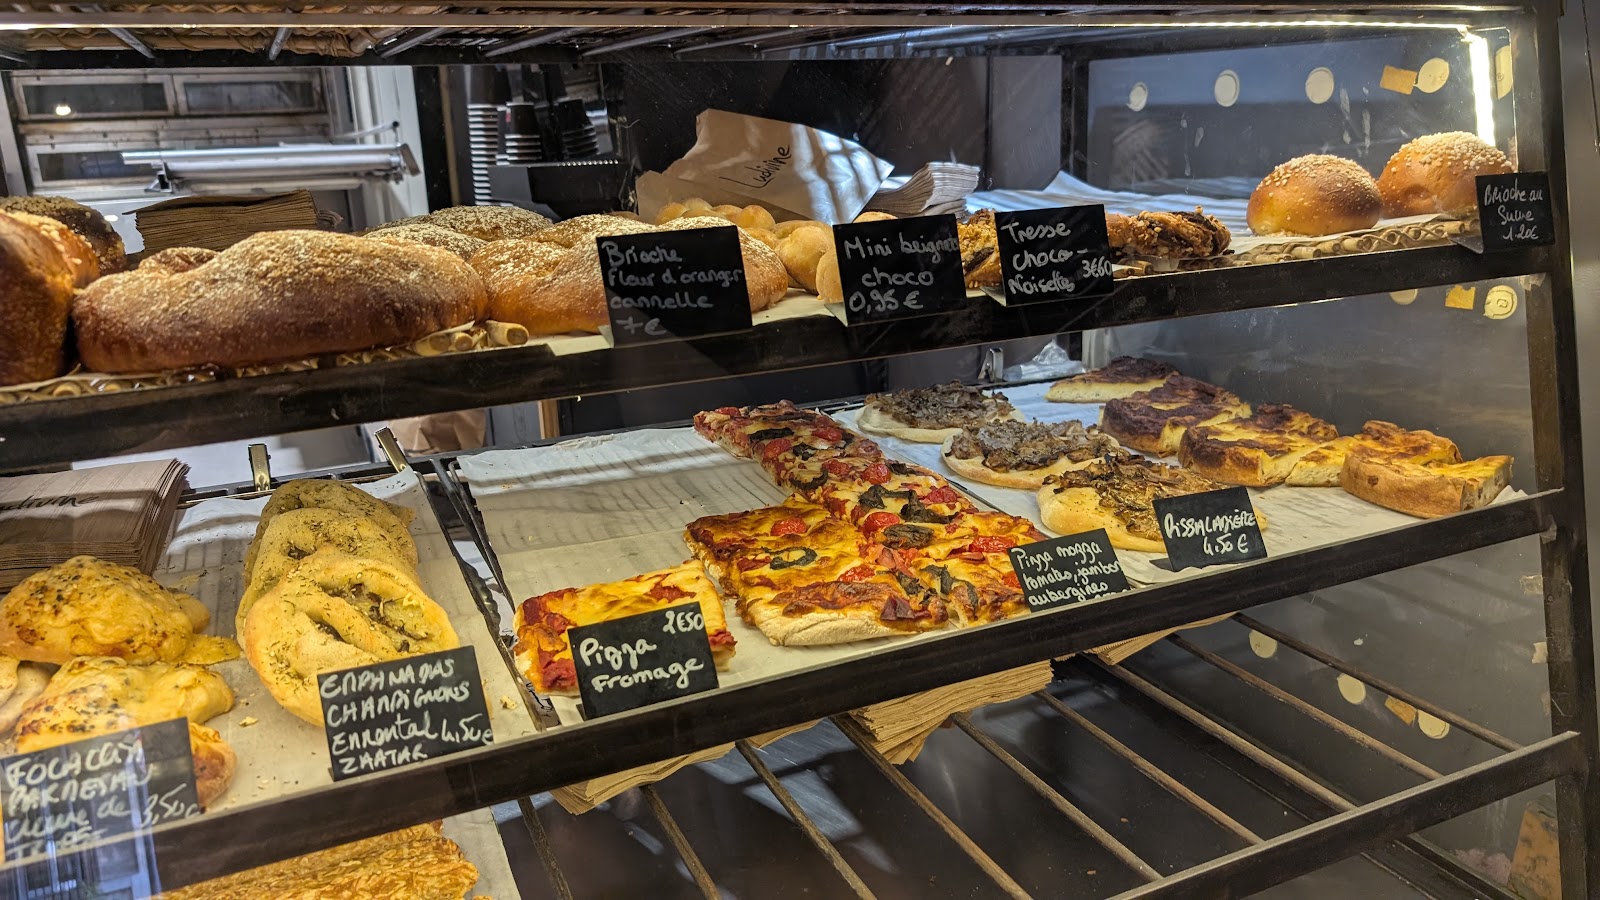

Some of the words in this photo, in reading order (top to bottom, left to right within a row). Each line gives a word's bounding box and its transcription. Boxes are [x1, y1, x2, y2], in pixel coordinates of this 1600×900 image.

[719, 144, 792, 188] Ludivine
[1529, 189, 1543, 202] au
[1001, 222, 1071, 244] Tresse
[601, 241, 683, 267] Brioche
[844, 236, 893, 260] Mini
[862, 267, 934, 287] choco
[1082, 256, 1112, 278] 3€60
[609, 291, 714, 309] cannelle
[1011, 548, 1053, 572] Pizza
[1056, 541, 1102, 564] mozza
[1028, 581, 1108, 606] aubergines
[579, 637, 657, 671] Pizza
[591, 657, 704, 693] Fromage
[97, 796, 132, 819] de
